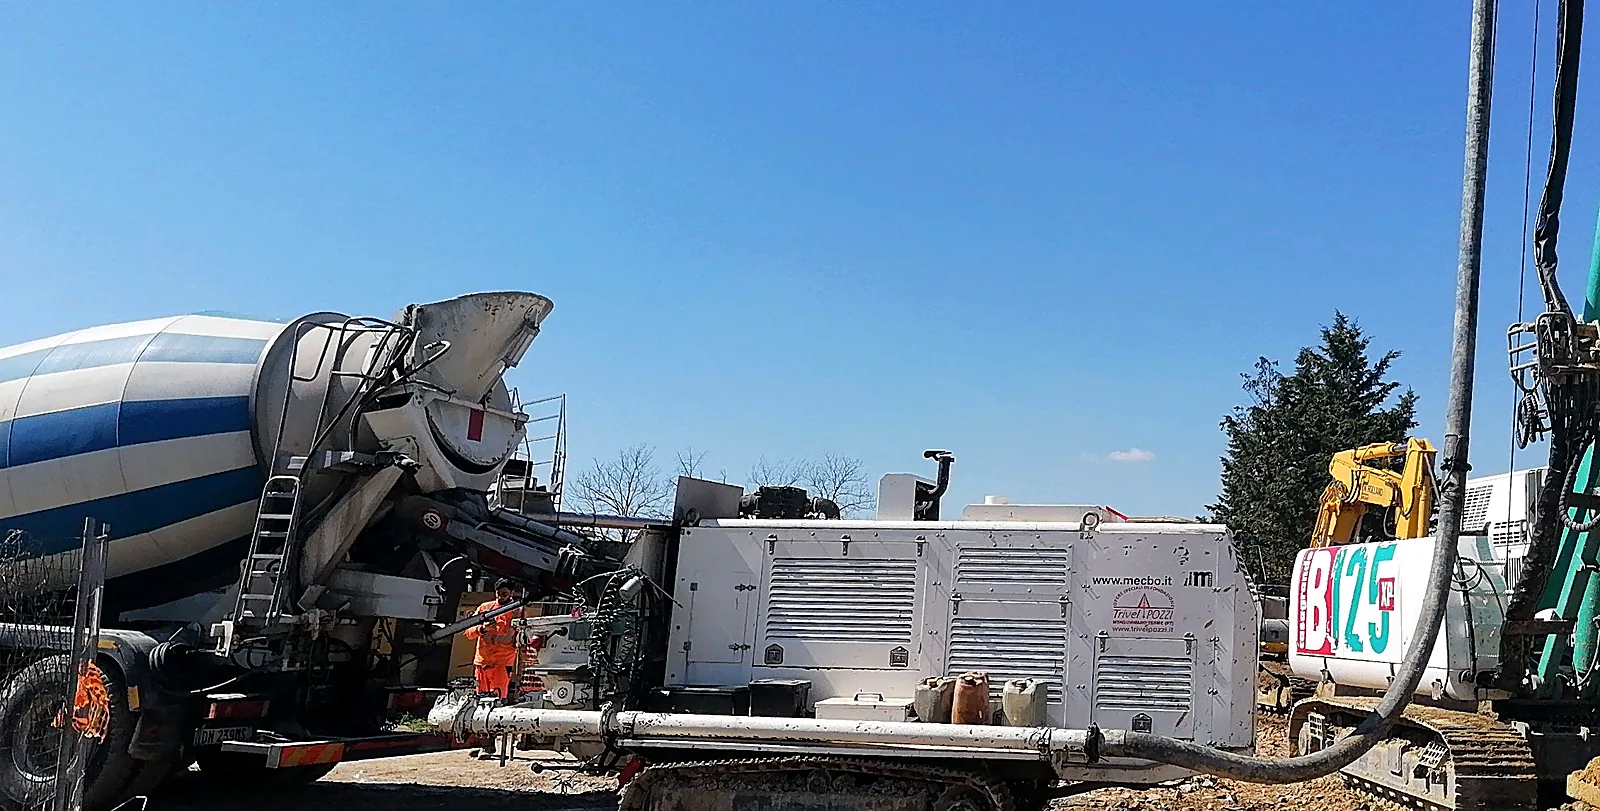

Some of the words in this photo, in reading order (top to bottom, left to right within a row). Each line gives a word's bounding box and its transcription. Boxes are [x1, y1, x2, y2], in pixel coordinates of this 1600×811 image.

[425, 515, 438, 527] 60
[1092, 576, 1172, 586] www.mecbo.it
[1381, 581, 1395, 607] XP
[1113, 609, 1141, 619] Trivel
[1146, 610, 1174, 620] POZZI
